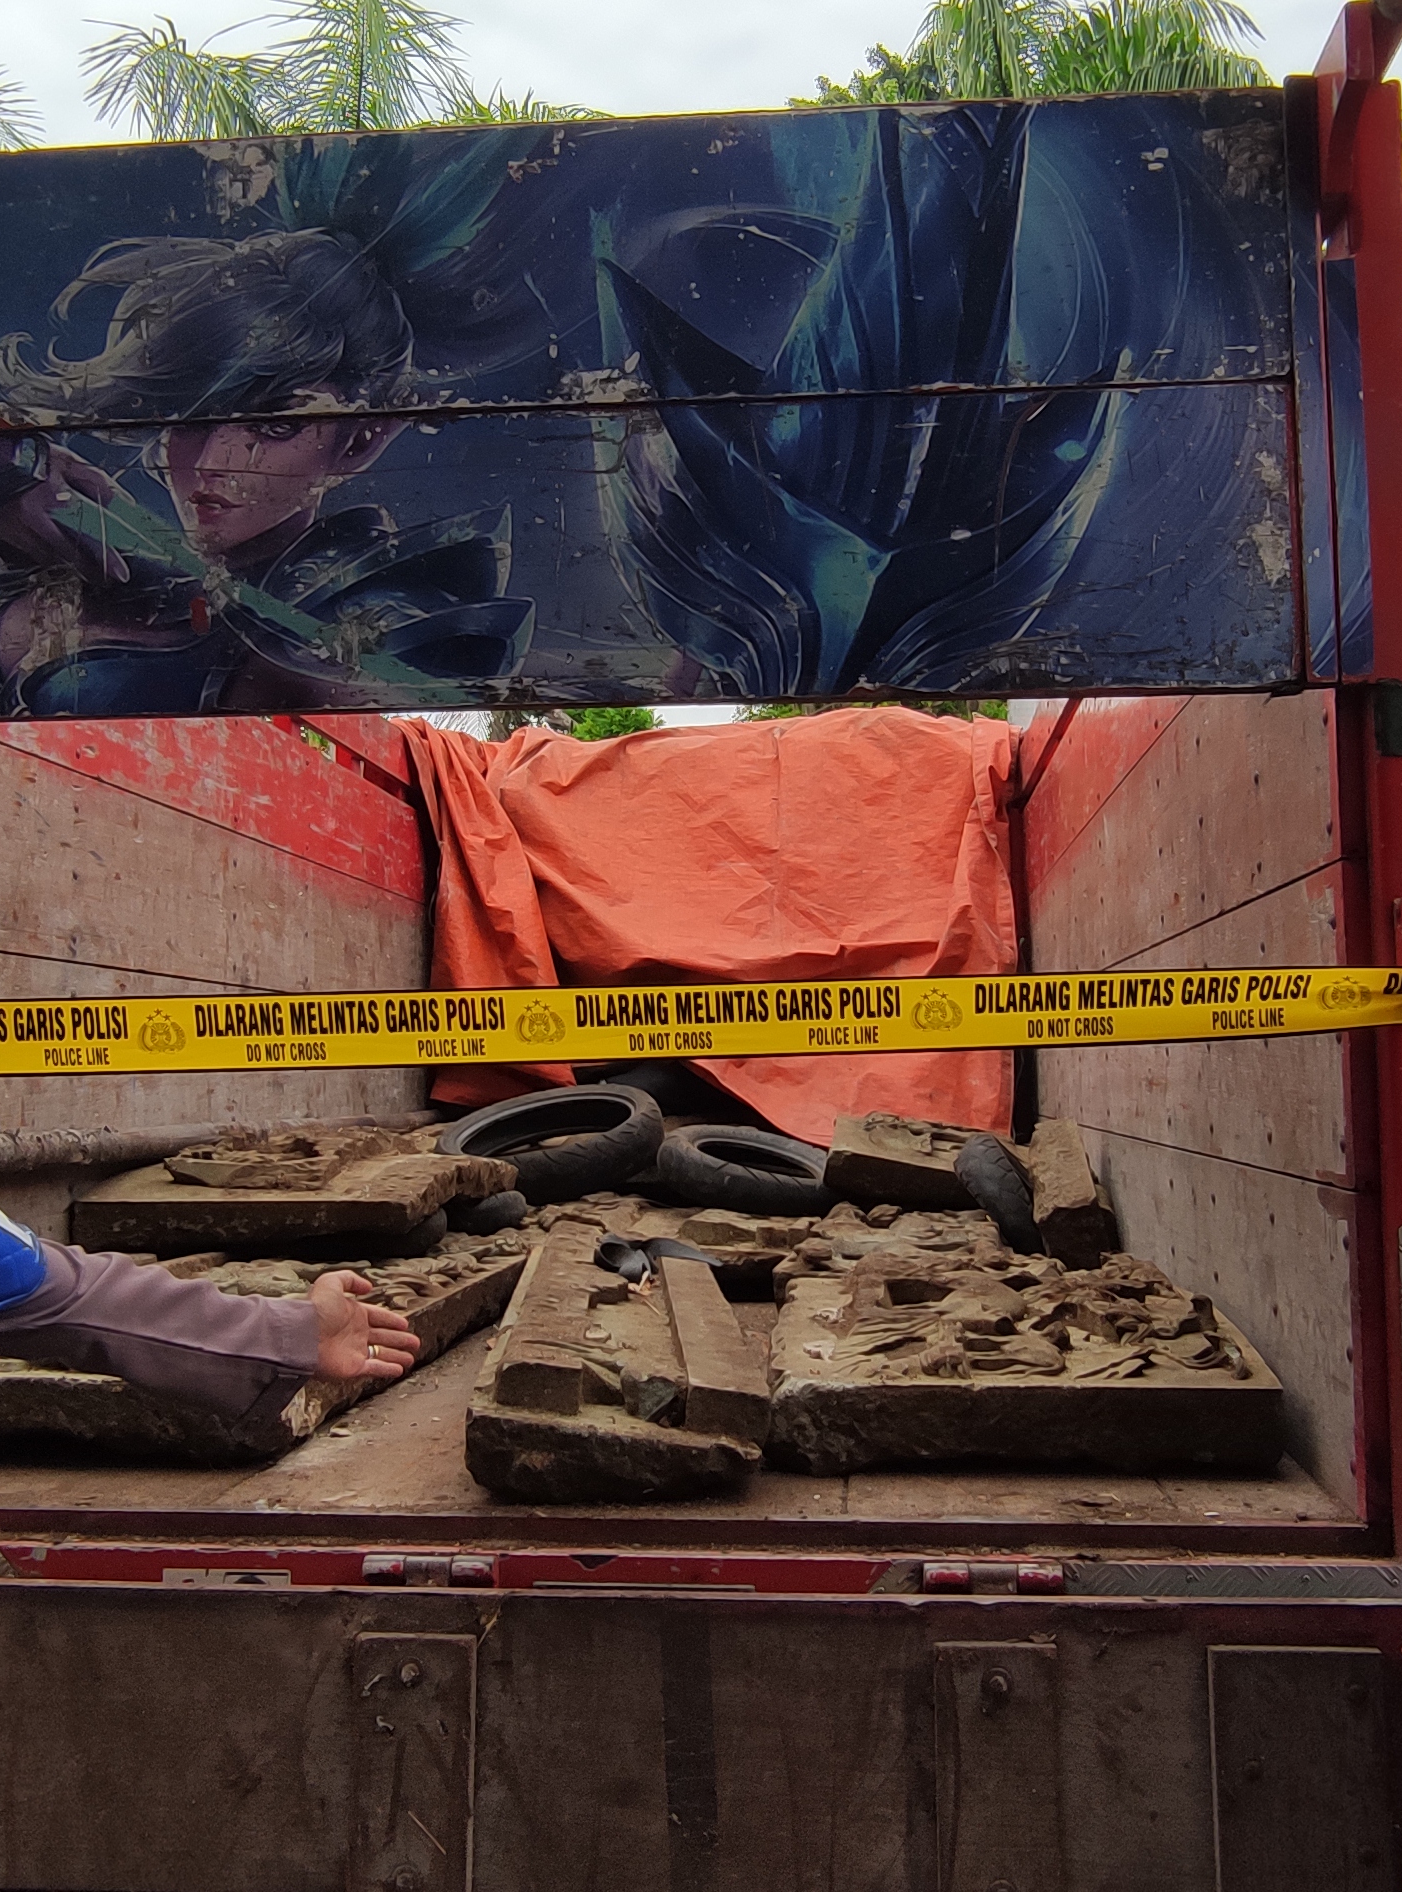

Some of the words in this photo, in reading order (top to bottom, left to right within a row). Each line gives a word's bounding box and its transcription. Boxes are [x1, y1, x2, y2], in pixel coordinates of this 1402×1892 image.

[974, 980, 1071, 1014] DILARANG
[1078, 978, 1175, 1011] MELINTAS
[1181, 976, 1241, 1005] GARIS
[1245, 974, 1312, 1002] POLISI
[194, 1002, 284, 1037] DILARANG
[289, 1000, 380, 1036] MELINTAS
[385, 998, 440, 1033] GARIS
[446, 997, 506, 1032] POLISI
[575, 993, 669, 1027] DILARANG
[675, 989, 769, 1024] MELINTAS
[775, 987, 832, 1021] GARIS
[838, 985, 901, 1020] POLISI
[13, 1006, 66, 1041] GARIS
[71, 1005, 129, 1040] POLISI
[1027, 1019, 1044, 1038] DO
[1047, 1018, 1071, 1038] NOT
[1074, 1016, 1114, 1036] CROSS
[1212, 1009, 1255, 1030] POLICE
[1258, 1008, 1285, 1028] LINE
[629, 1033, 644, 1051] DO
[649, 1032, 670, 1051] NOT
[674, 1031, 713, 1050] CROSS
[808, 1027, 849, 1046] POLICE
[854, 1026, 879, 1045] LINE
[44, 1048, 83, 1067] POLICE
[86, 1047, 110, 1066] LINE
[246, 1044, 261, 1062] DO
[265, 1043, 286, 1062] NOT
[290, 1042, 327, 1061] CROSS
[418, 1039, 457, 1058] POLICE
[461, 1038, 486, 1056] LINE
